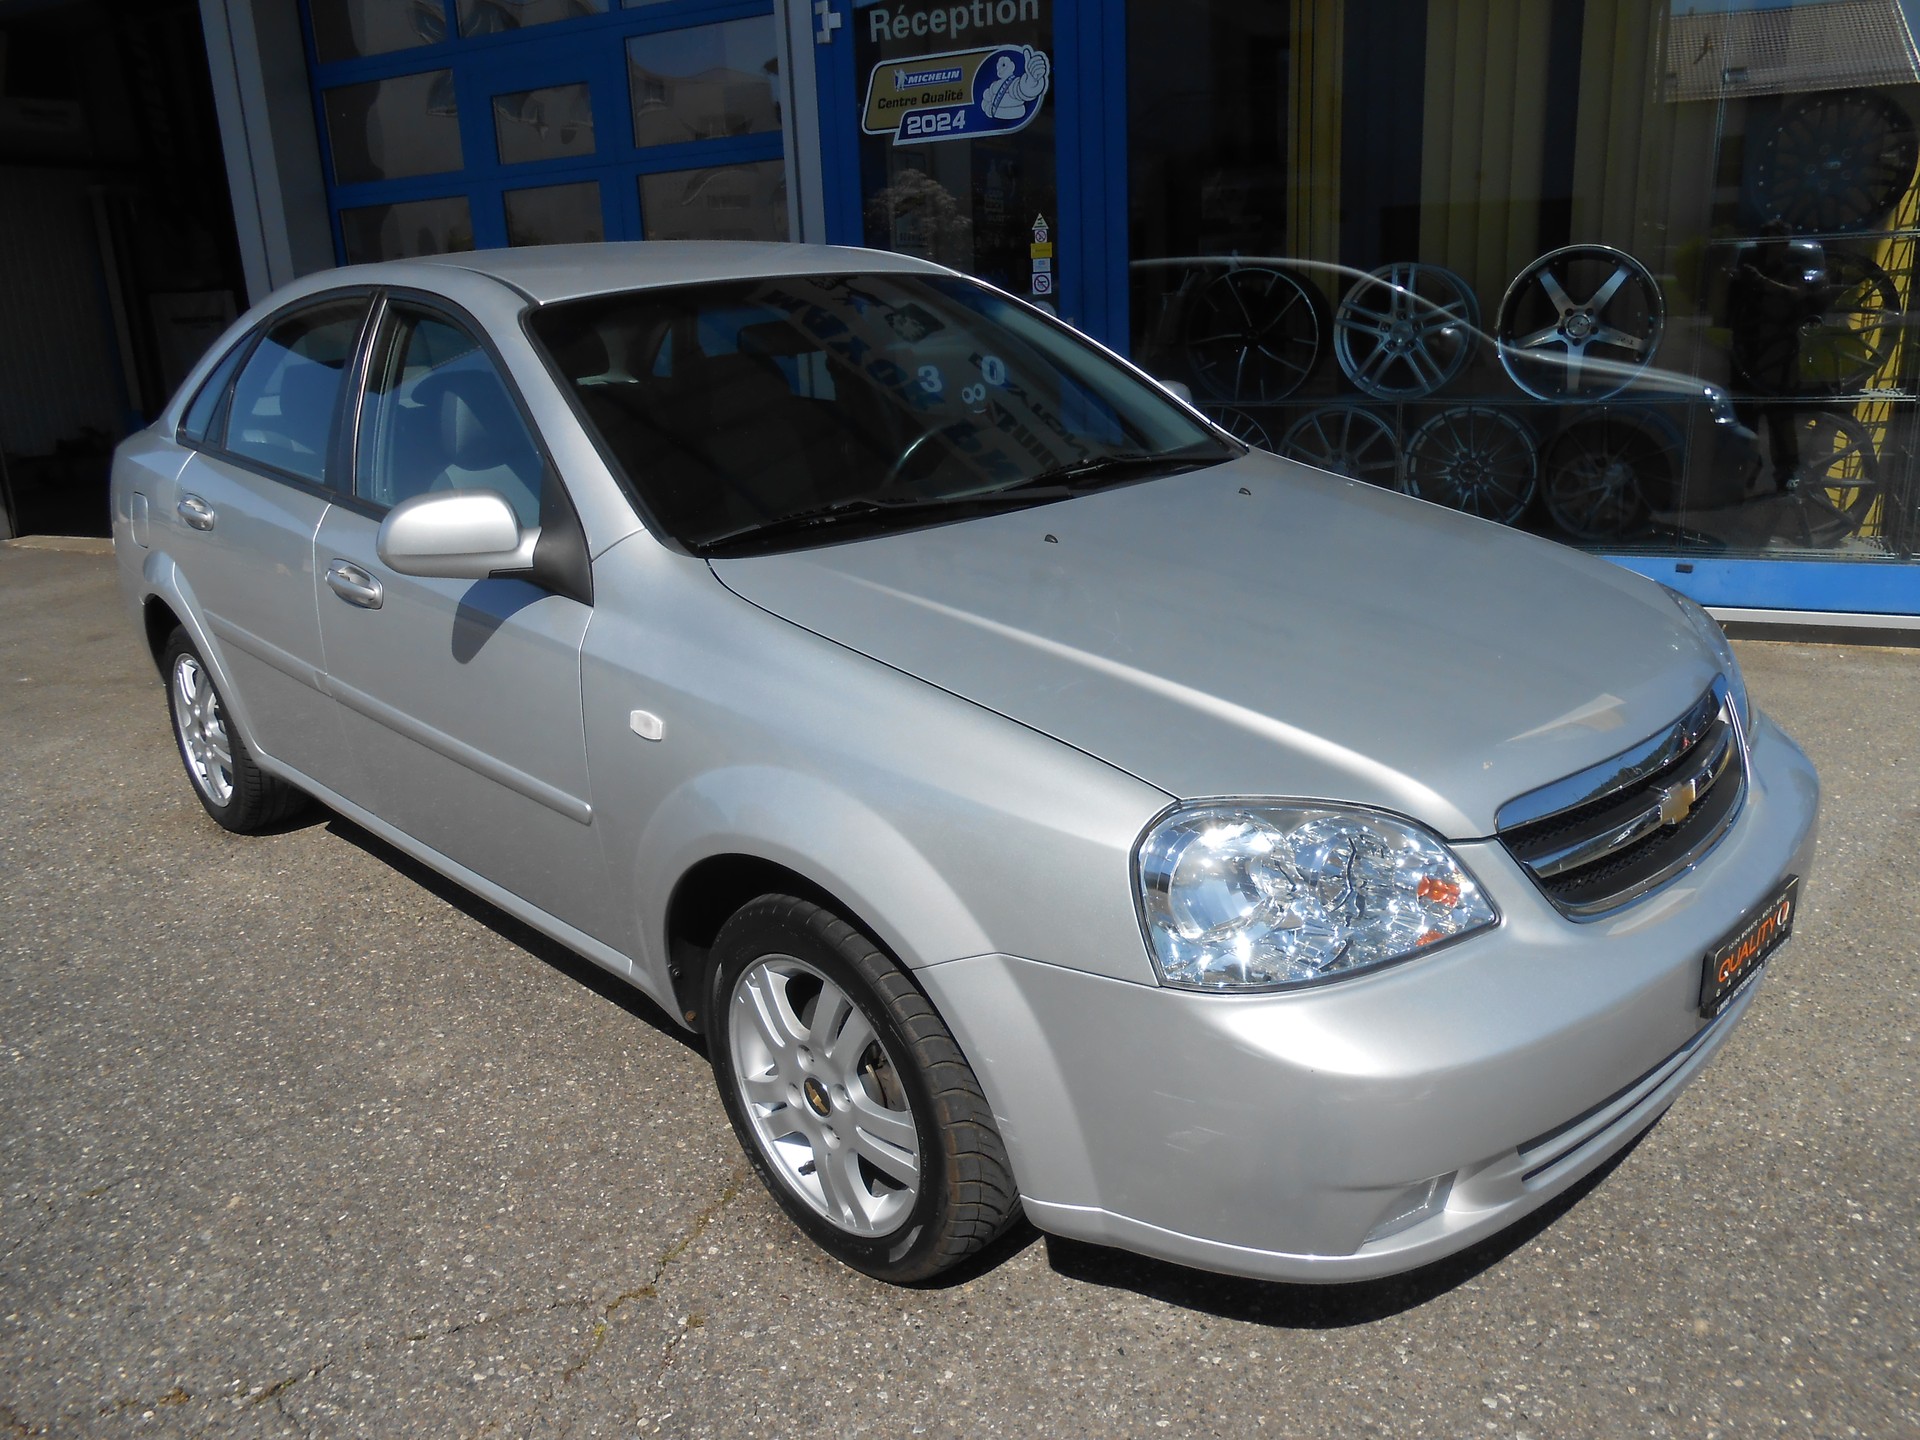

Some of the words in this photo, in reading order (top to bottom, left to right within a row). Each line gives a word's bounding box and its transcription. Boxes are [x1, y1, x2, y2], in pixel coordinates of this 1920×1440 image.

[869, 0, 1039, 43] Réception
[907, 70, 960, 85] MICHELIN
[878, 96, 917, 110] Centre
[921, 90, 964, 105] Qualité
[907, 110, 966, 134] 2024
[1718, 911, 1779, 982] QUALITY
